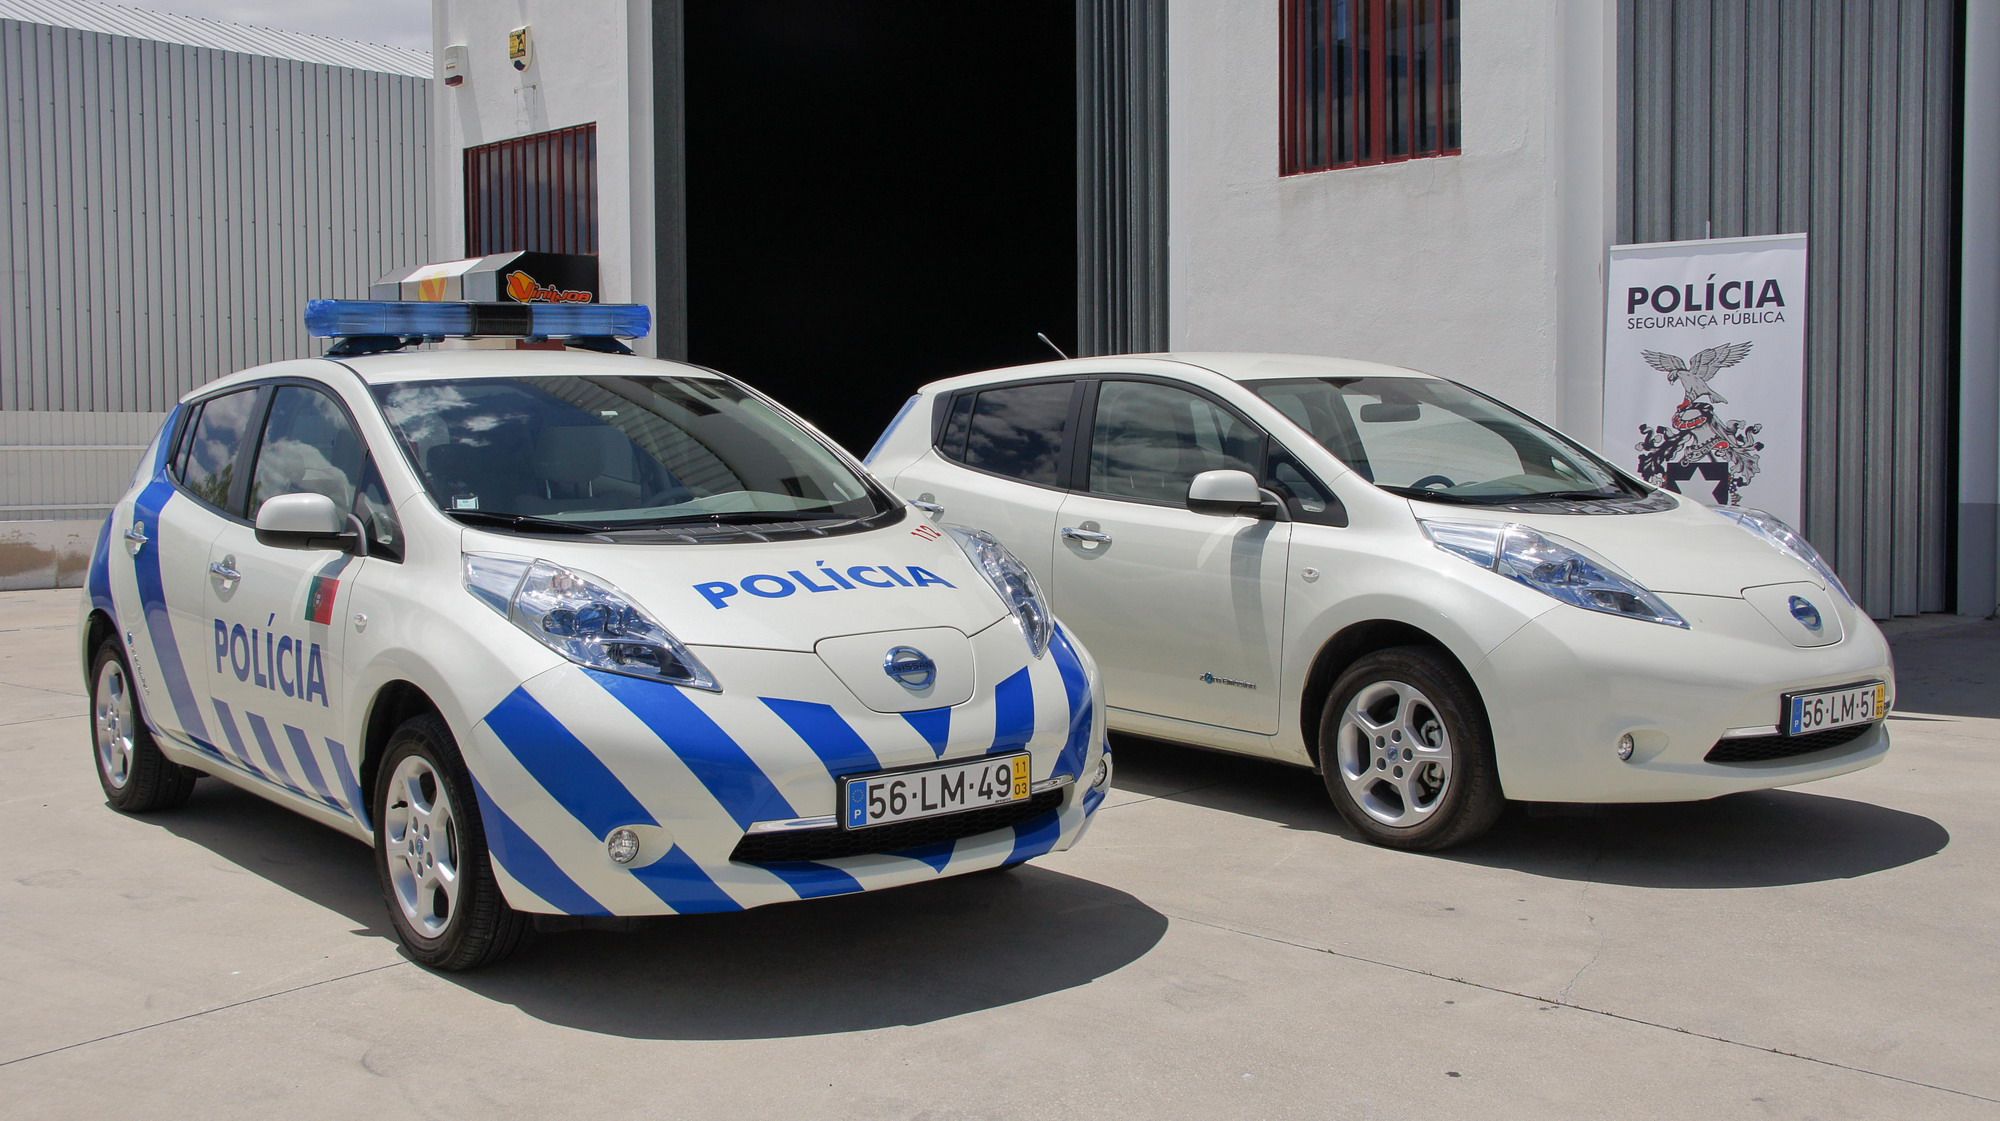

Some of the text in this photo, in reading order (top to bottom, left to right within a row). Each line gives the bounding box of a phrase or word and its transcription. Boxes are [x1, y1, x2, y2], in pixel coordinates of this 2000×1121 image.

[1627, 273, 1785, 315] POLÍCIA
[1627, 310, 1785, 330] SEGURANÇA PÚBLICA
[911, 524, 942, 542] 112
[692, 560, 959, 610] POLÍCIA
[214, 612, 329, 708] POLÍCIA
[1015, 761, 1027, 774] 11
[1014, 782, 1028, 796] 03
[853, 809, 862, 820] P
